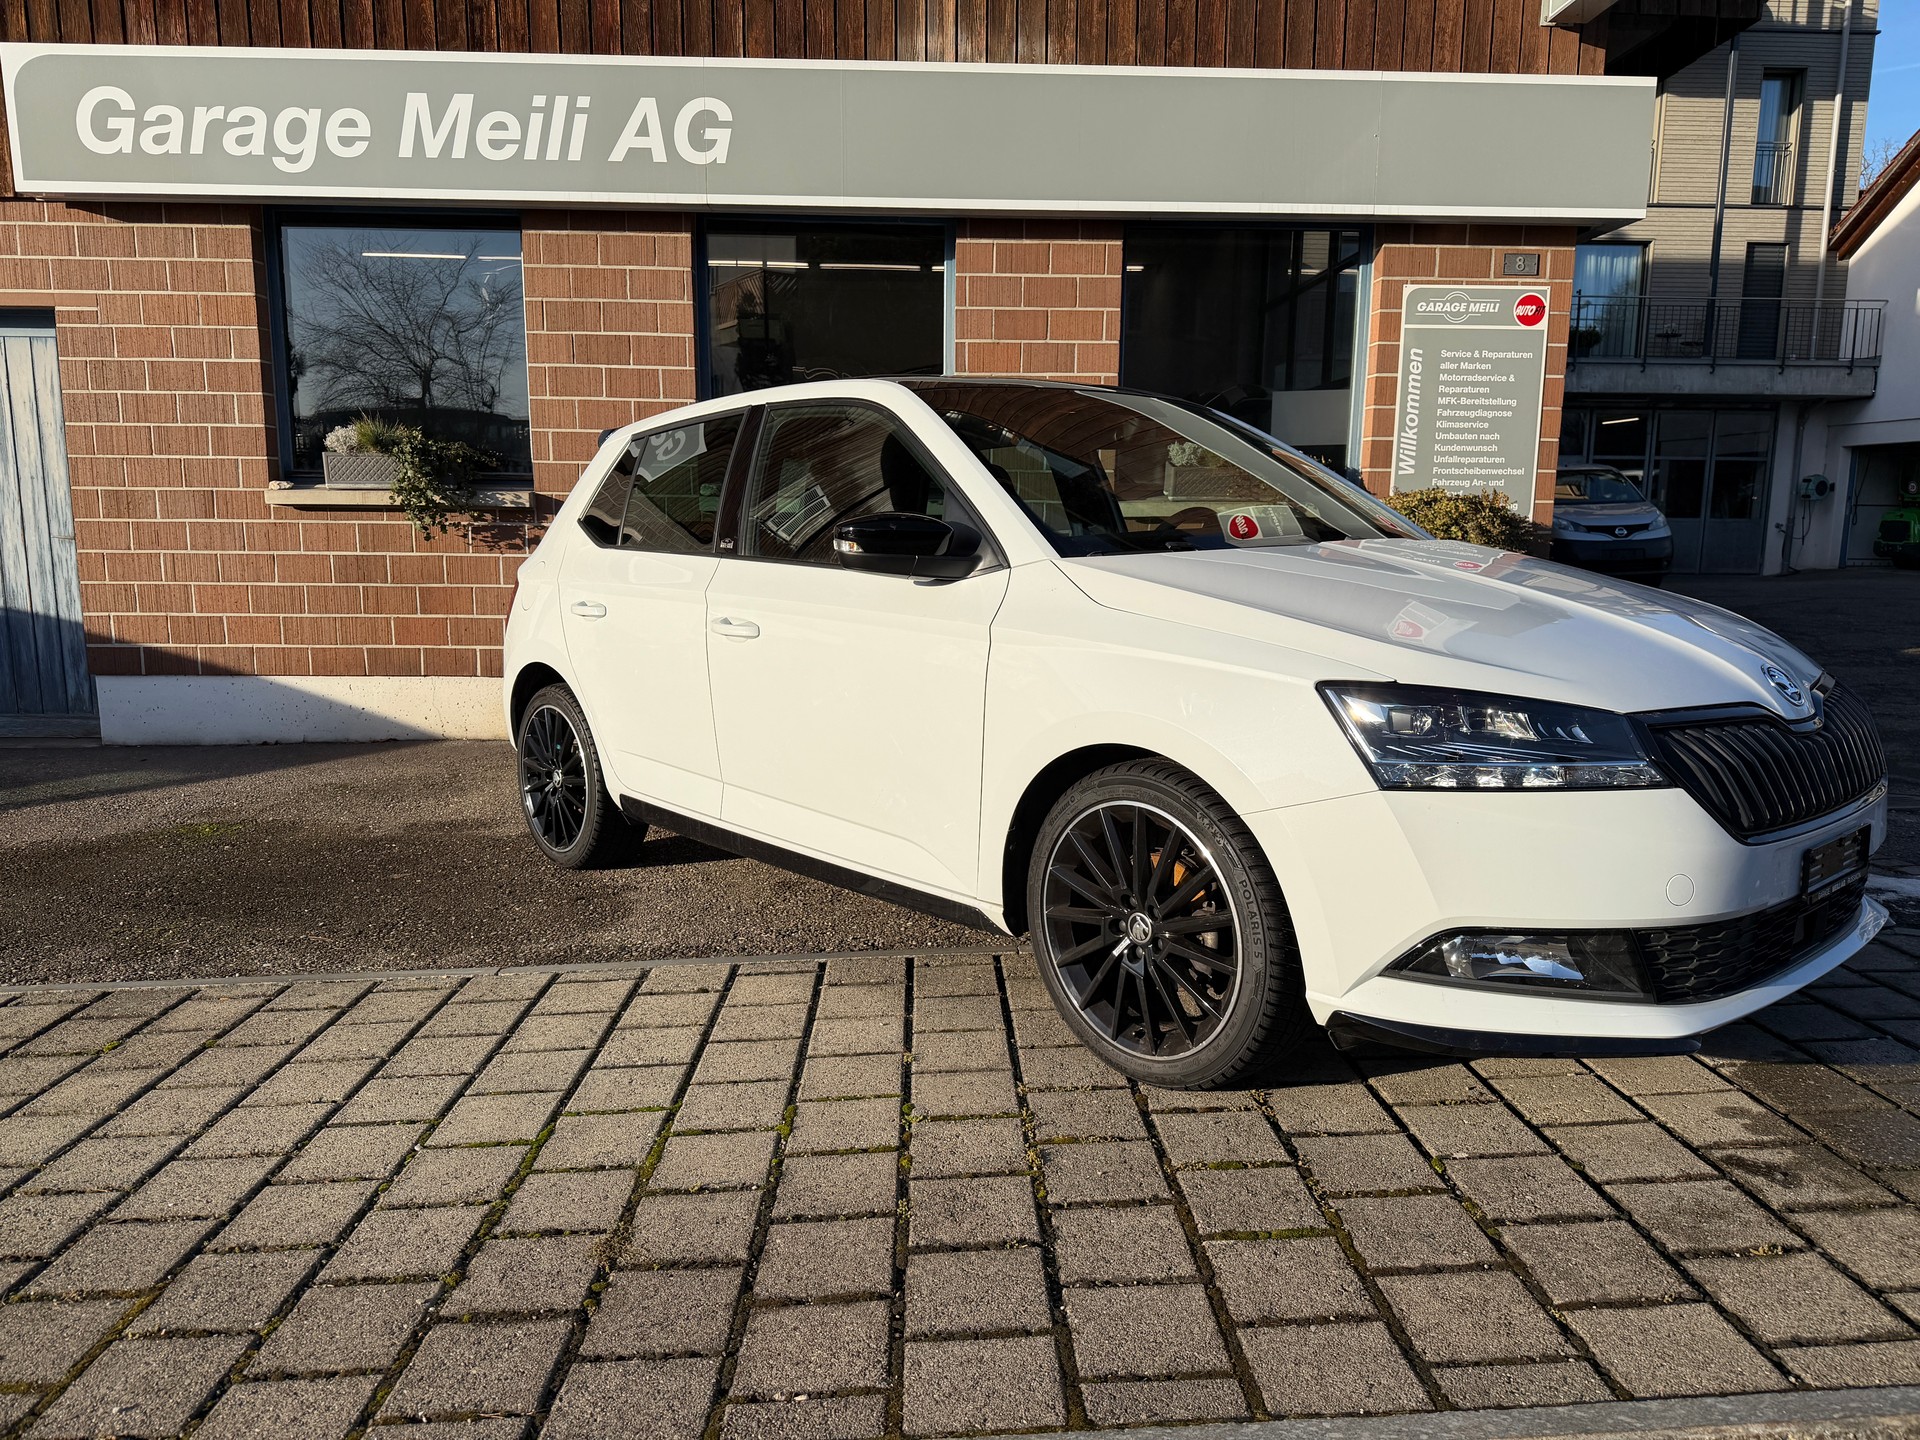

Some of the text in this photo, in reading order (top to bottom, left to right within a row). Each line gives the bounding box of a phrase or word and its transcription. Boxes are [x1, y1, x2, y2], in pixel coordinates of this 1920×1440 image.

[76, 86, 733, 173] Garage Meili AG
[1515, 256, 1526, 272] 8
[1416, 302, 1500, 313] GARAGE MEILI
[1440, 349, 1533, 360] Service & Reparaturen
[1440, 362, 1492, 370] aller Marken
[1439, 373, 1516, 382] Motorradservice &
[1438, 385, 1490, 394] Reparaturen
[1437, 397, 1517, 407] MFK-Bereitstellung
[1398, 347, 1424, 476] Willkommen
[1436, 408, 1513, 418] Fahrzeugdiagnose
[1435, 420, 1489, 429] Klimaservice
[1435, 432, 1478, 440] Umbauten
[1434, 443, 1498, 452] Kundenwunsch
[1433, 455, 1506, 465] Unfallreparaturen
[1432, 466, 1525, 475] Frontscheibenwechsel
[1431, 478, 1471, 488] Fahrzeug
[1471, 478, 1487, 486] An-
[1238, 879, 1263, 959] POLARIS 5
